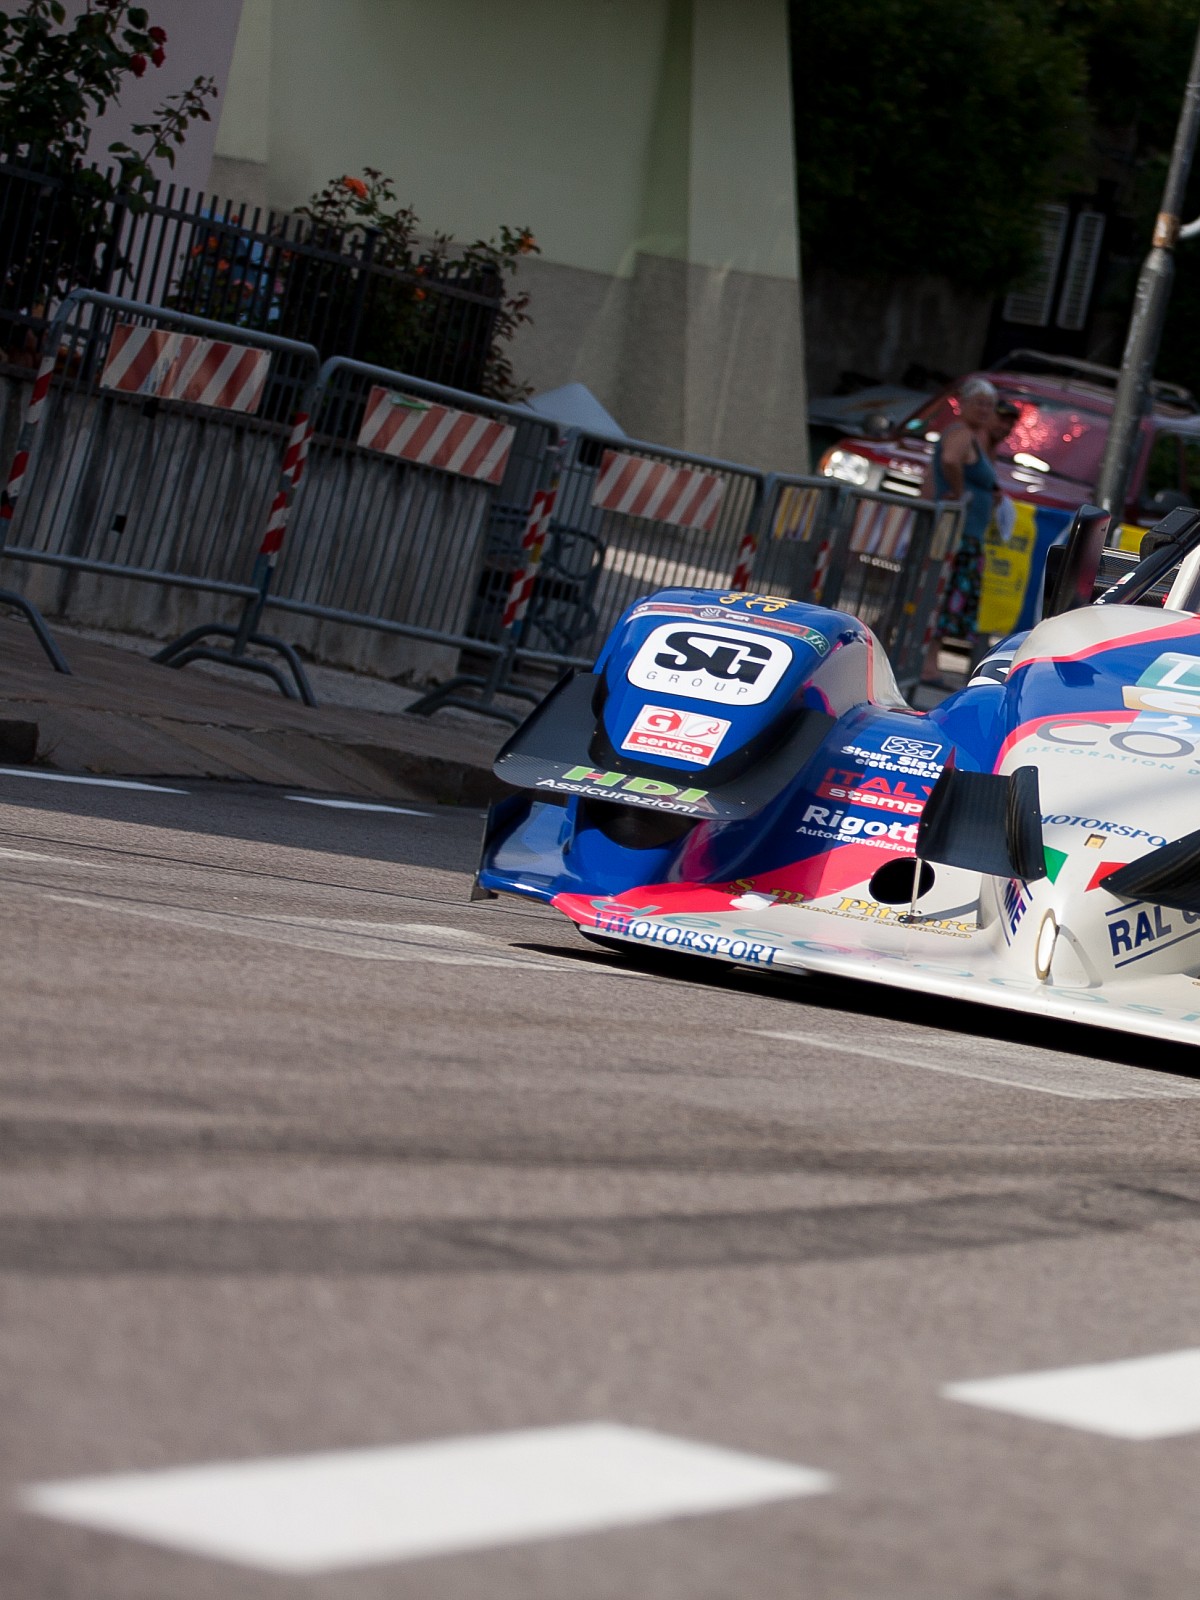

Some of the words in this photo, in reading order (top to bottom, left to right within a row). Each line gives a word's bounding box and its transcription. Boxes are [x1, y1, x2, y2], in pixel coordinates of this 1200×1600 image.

[655, 631, 772, 685] SG
[646, 671, 748, 696] GROUP
[636, 736, 704, 755] service
[840, 745, 892, 762] Sicur
[855, 758, 941, 780] elettronica
[1025, 746, 1175, 771] DECORATION
[535, 778, 700, 814] Assicurazioni
[561, 765, 710, 803] HDI
[1108, 906, 1172, 956] RAL
